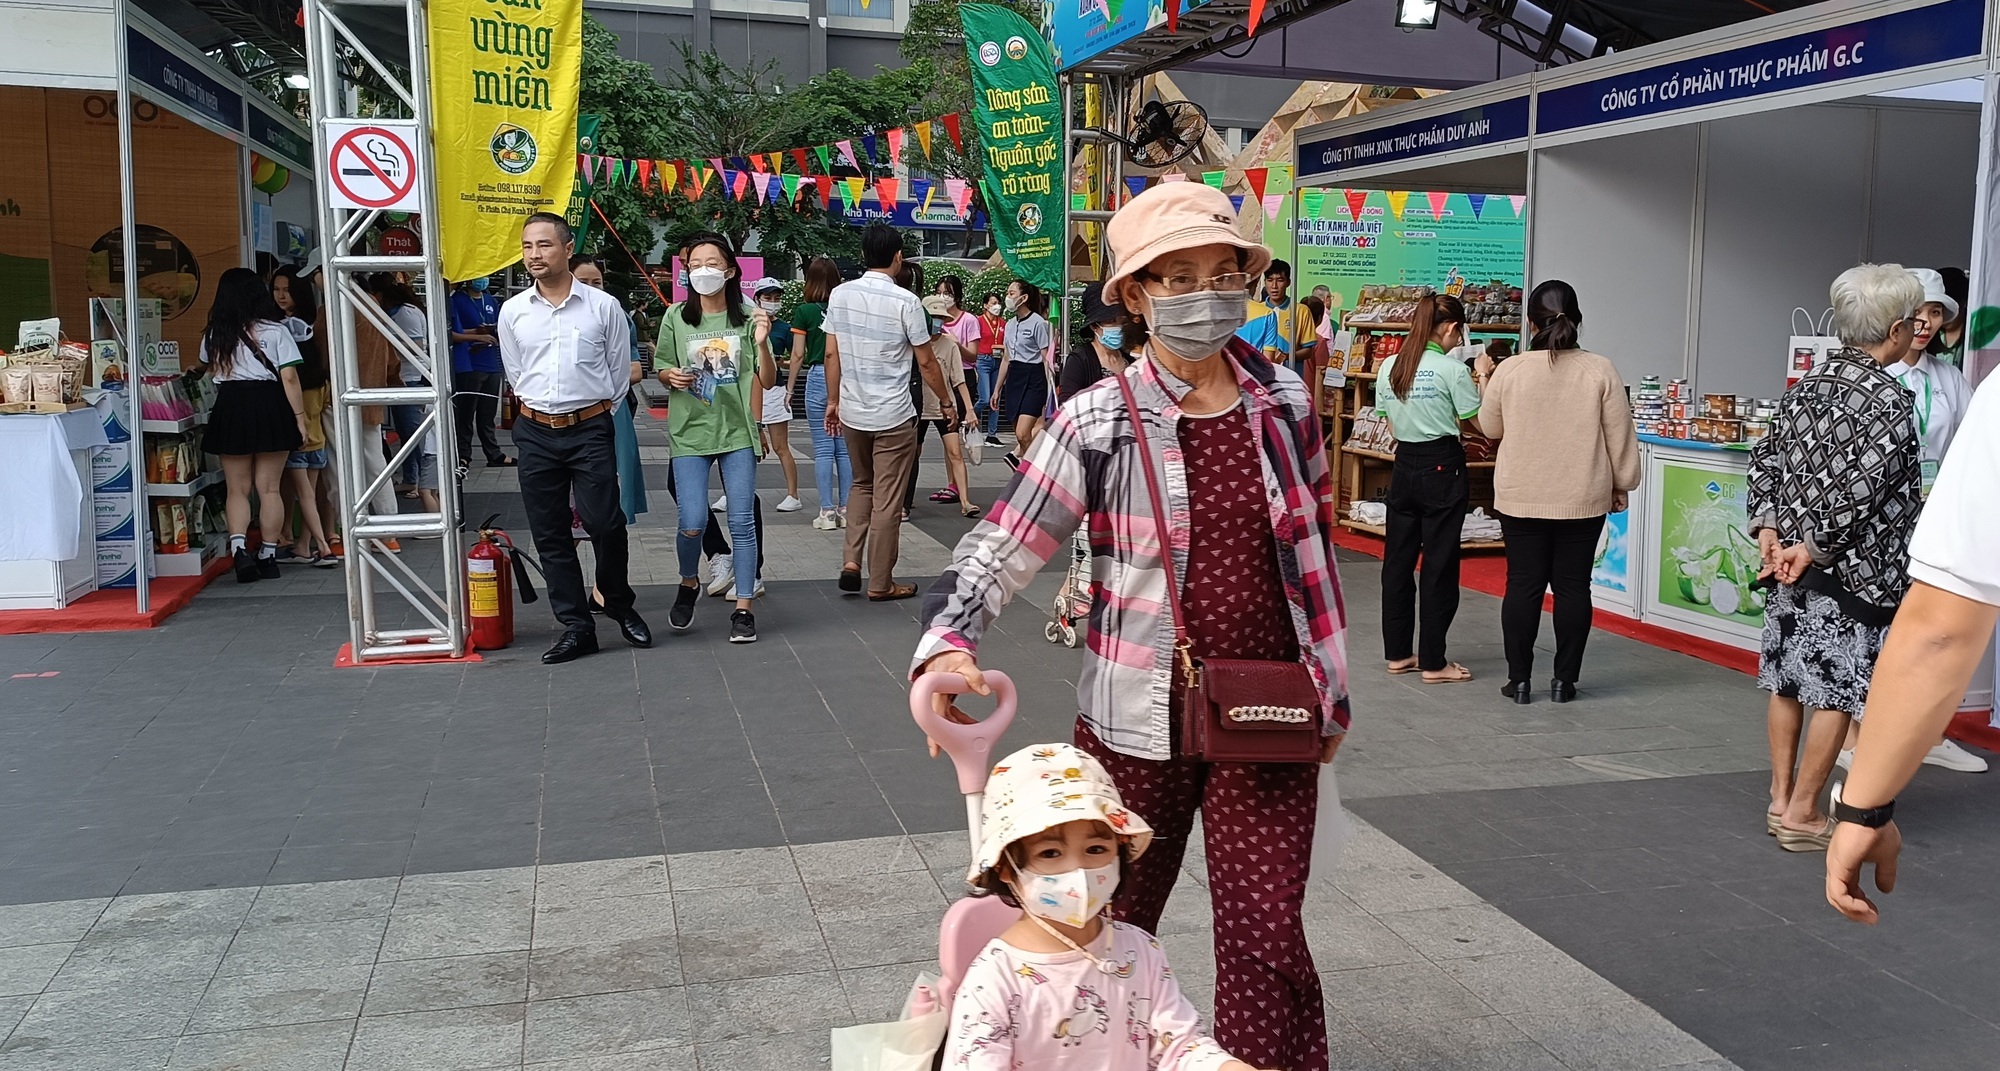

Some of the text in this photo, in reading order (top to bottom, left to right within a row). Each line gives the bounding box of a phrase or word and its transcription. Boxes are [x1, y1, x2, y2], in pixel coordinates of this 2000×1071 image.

[470, 10, 553, 70] vùng
[163, 64, 178, 90] CÔNG
[472, 60, 553, 111] miền
[1600, 41, 1865, 112] CÔNG TY CỔ PHẦN THỰC PHẨM G.C
[985, 81, 1050, 112] Nông sản
[992, 119, 1011, 138] an
[1322, 119, 1490, 165] CÔNG TY TNHH XNK THỰC PHẨM DUY ANH
[988, 135, 1057, 172] Nguồn gốc
[1001, 171, 1051, 195] rõ ràng
[1298, 231, 1314, 245] UÂN
[1315, 232, 1330, 246] QUÝ
[1332, 233, 1350, 247] MÃO
[1327, 221, 1348, 232] XANH
[1367, 220, 1382, 234] VIỆT
